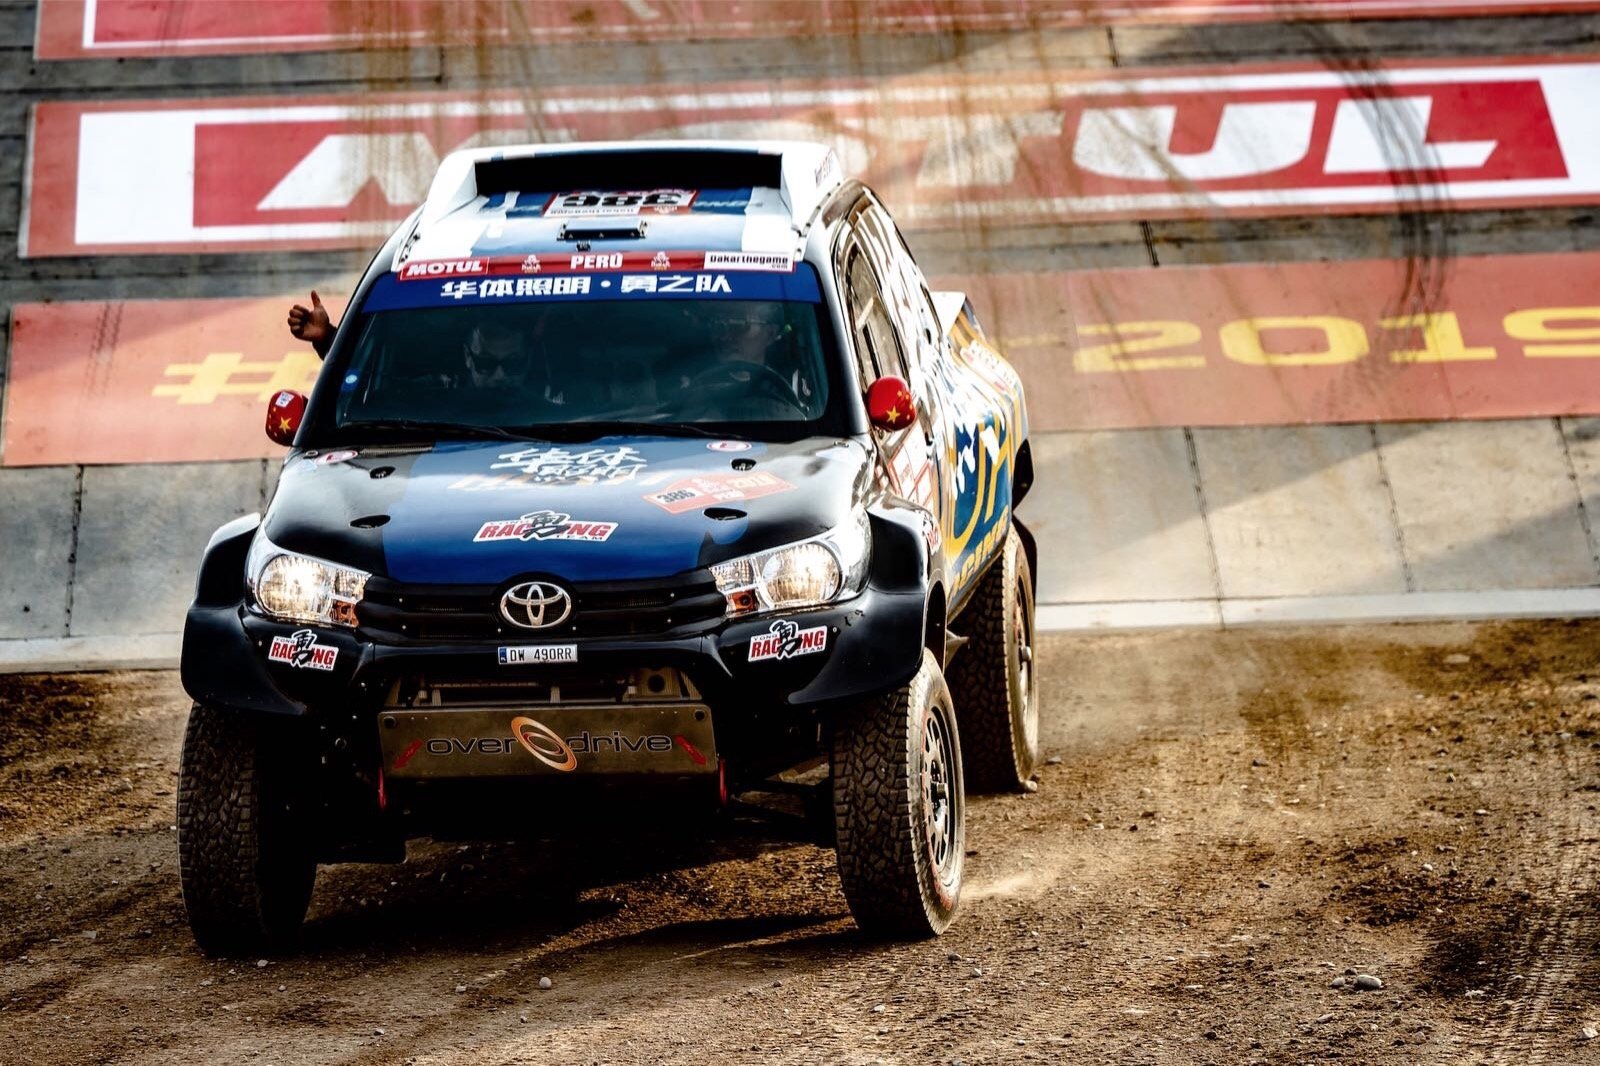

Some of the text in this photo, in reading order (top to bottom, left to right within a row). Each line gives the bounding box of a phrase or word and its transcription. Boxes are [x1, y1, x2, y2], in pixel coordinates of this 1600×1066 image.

[406, 261, 484, 276] MOTUL
[657, 489, 696, 503] 386
[510, 649, 525, 661] DW
[533, 647, 571, 661] 490RR
[426, 731, 674, 755] over drive
